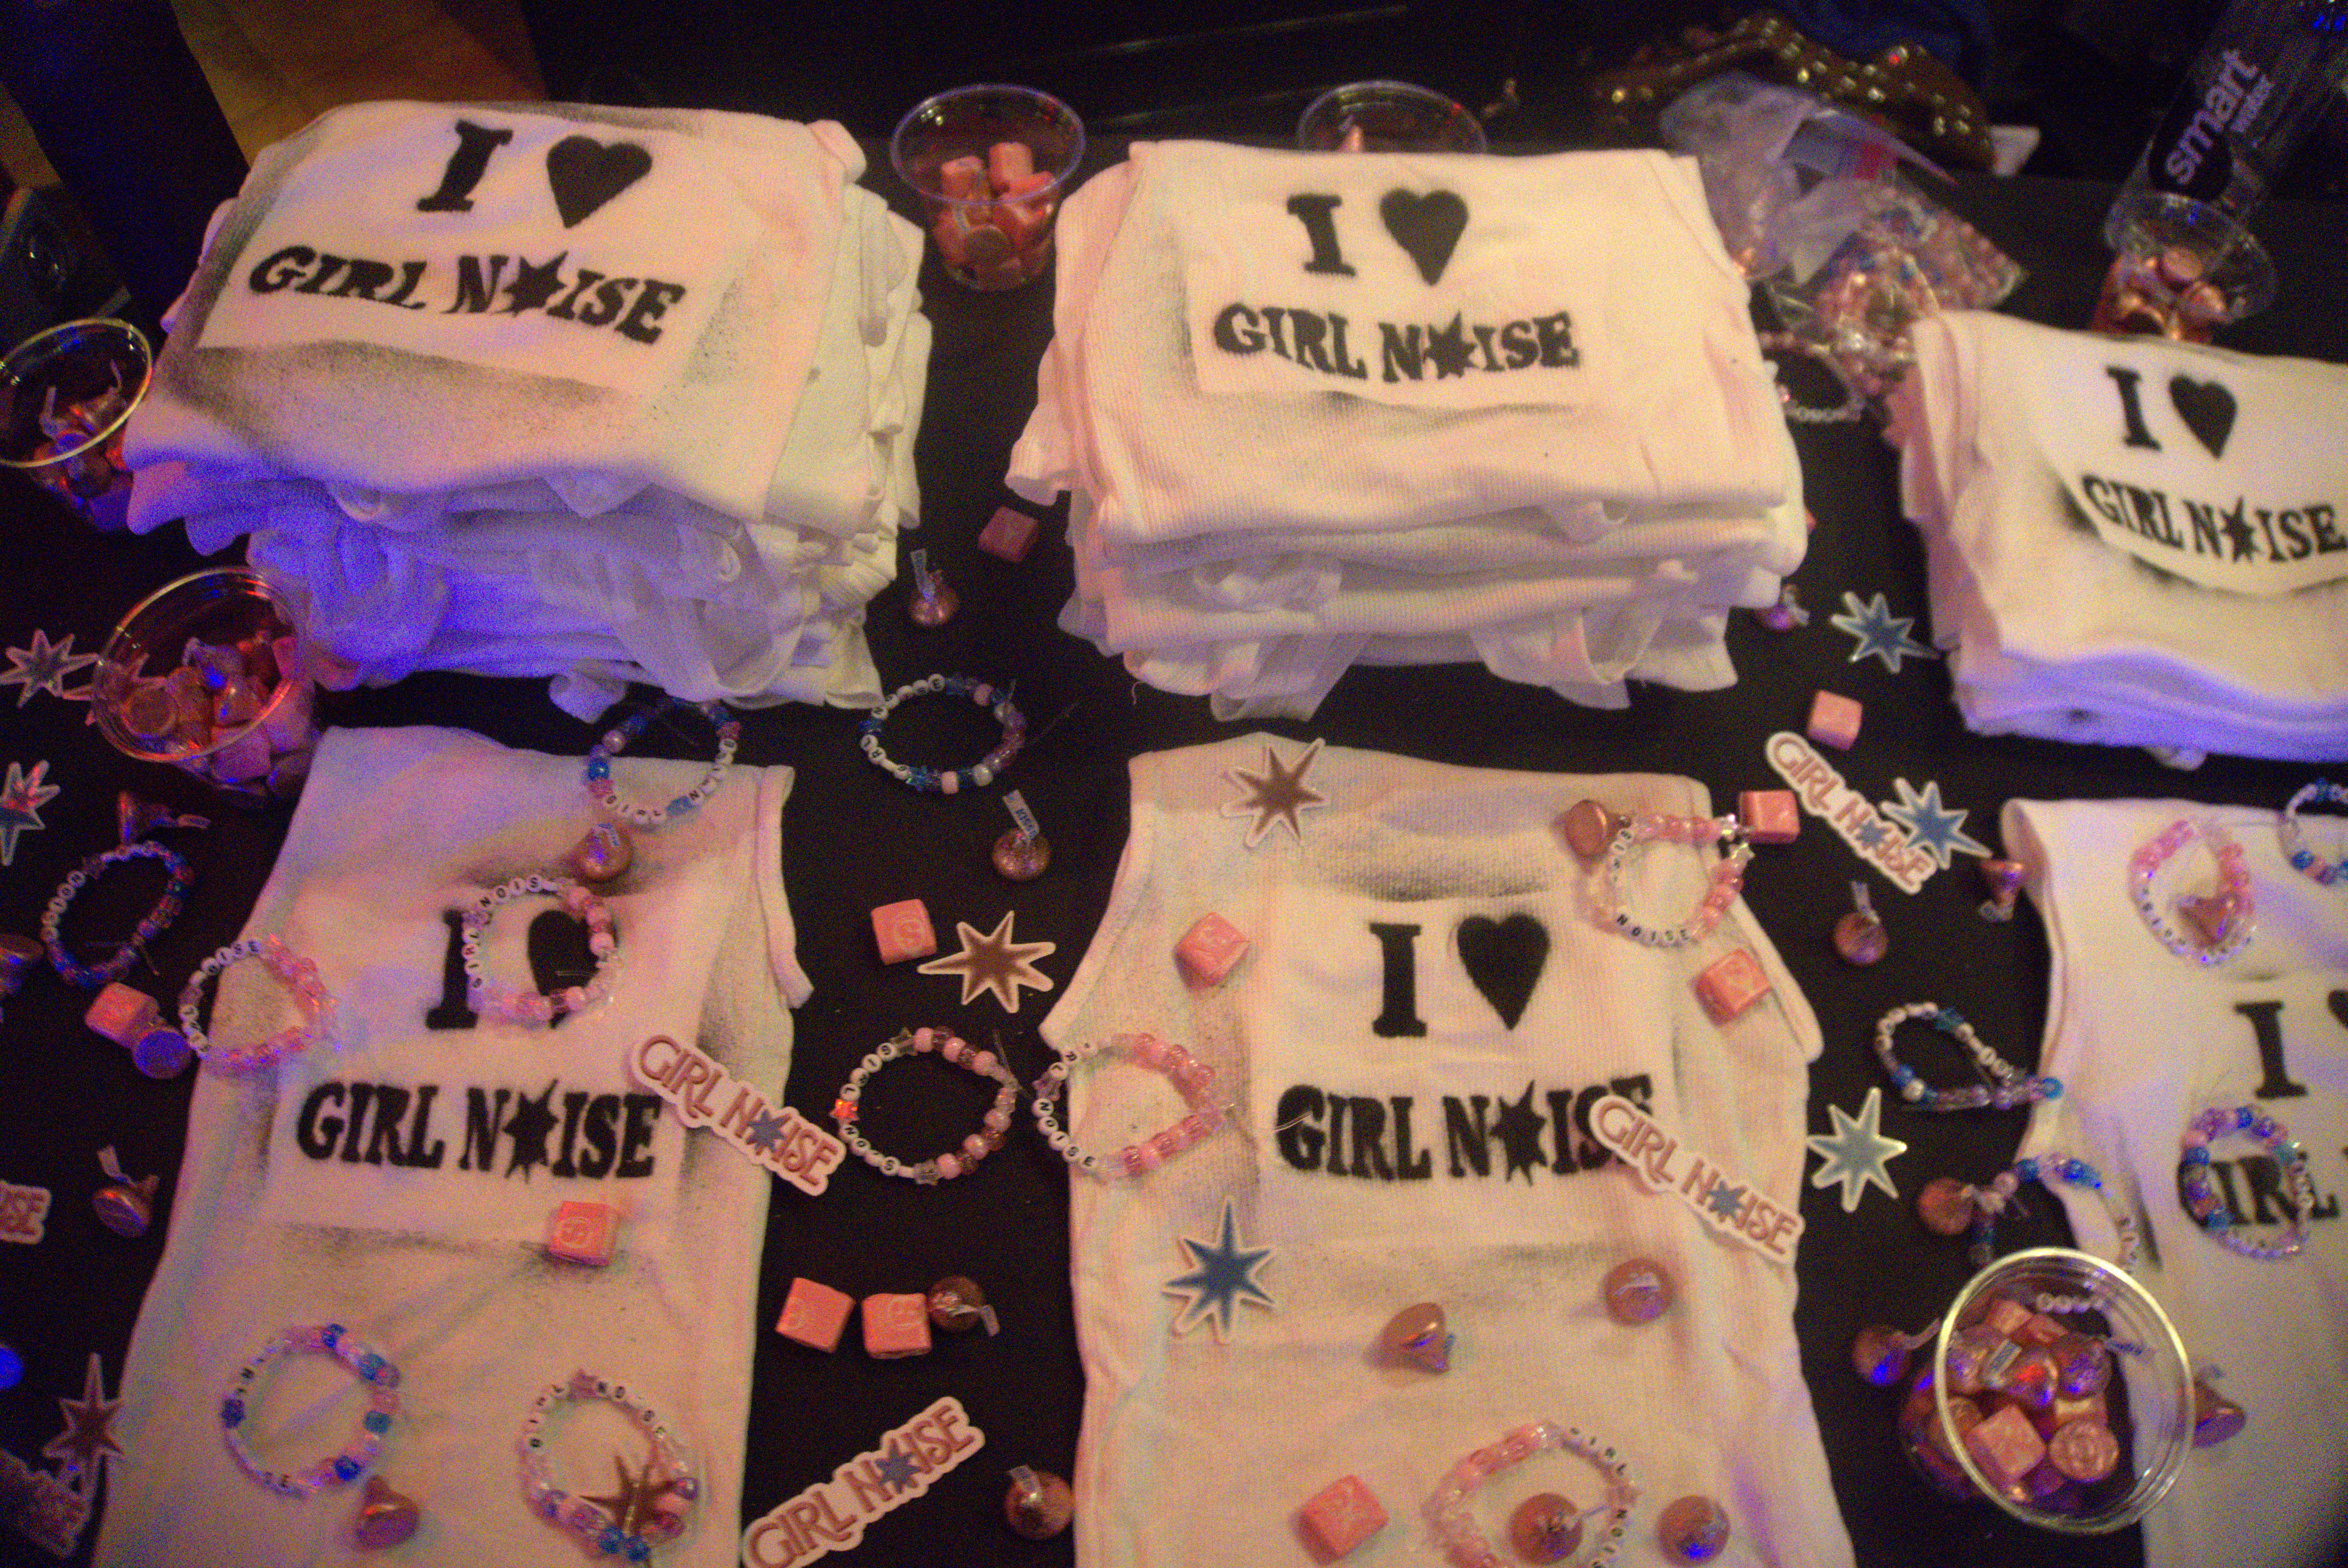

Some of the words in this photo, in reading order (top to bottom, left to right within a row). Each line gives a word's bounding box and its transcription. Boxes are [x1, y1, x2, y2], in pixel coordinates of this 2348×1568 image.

[2164, 49, 2258, 184] smart
[417, 120, 513, 212] I
[248, 245, 426, 310] GIRL
[1286, 193, 1355, 277] I
[1213, 303, 1367, 380] GIRL
[2106, 366, 2161, 451] I
[2081, 474, 2183, 549] GIRL
[1773, 737, 1838, 811] GIRL
[477, 875, 557, 908] NOIS
[425, 908, 479, 1031] I
[1369, 922, 1427, 1038] I
[639, 1034, 714, 1119] GIRL
[2235, 1001, 2307, 1100] I
[296, 1082, 445, 1169] GIRL
[1275, 1084, 1432, 1182] GIRL
[1597, 1099, 1678, 1185] GIRL
[749, 1489, 858, 1568] GIRL
